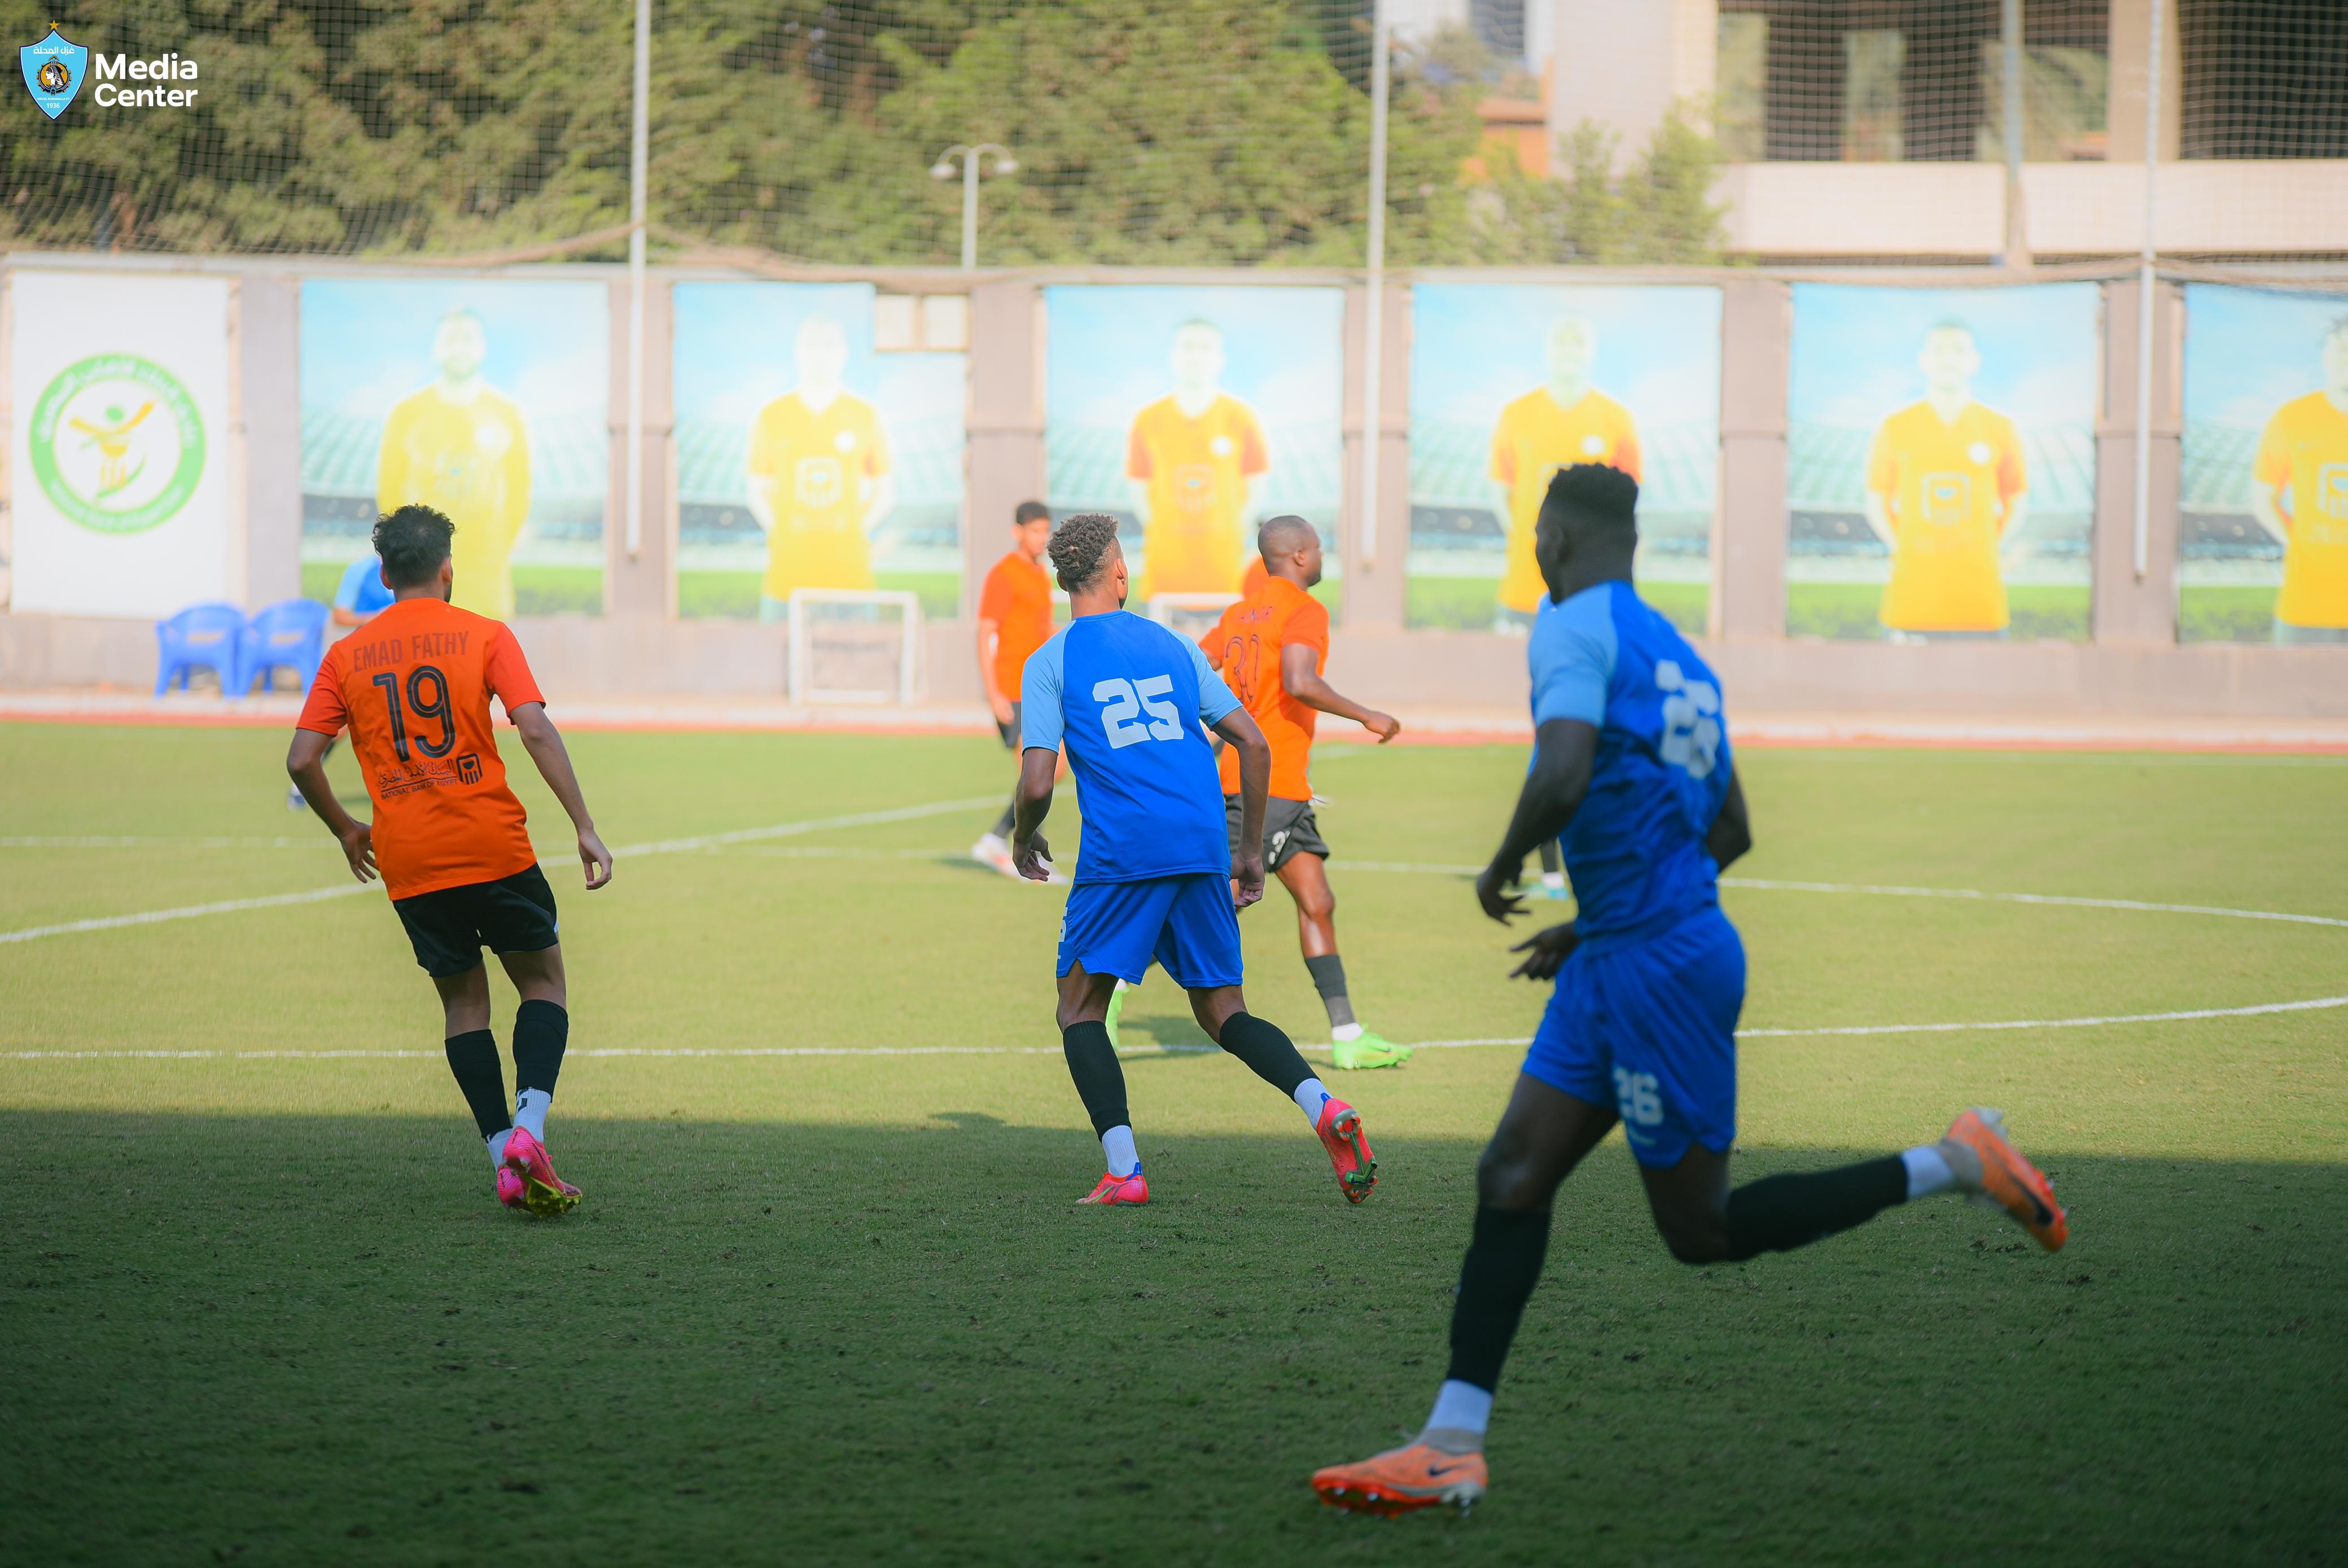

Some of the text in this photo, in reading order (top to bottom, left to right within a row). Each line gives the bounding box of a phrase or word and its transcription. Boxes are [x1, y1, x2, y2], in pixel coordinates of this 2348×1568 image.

[354, 631, 469, 672] EMAD FATHY
[373, 665, 455, 762] 19
[1092, 674, 1184, 749] 25
[381, 789, 410, 799] NATIONAL
[412, 782, 426, 792] BANK
[426, 780, 434, 789] OF
